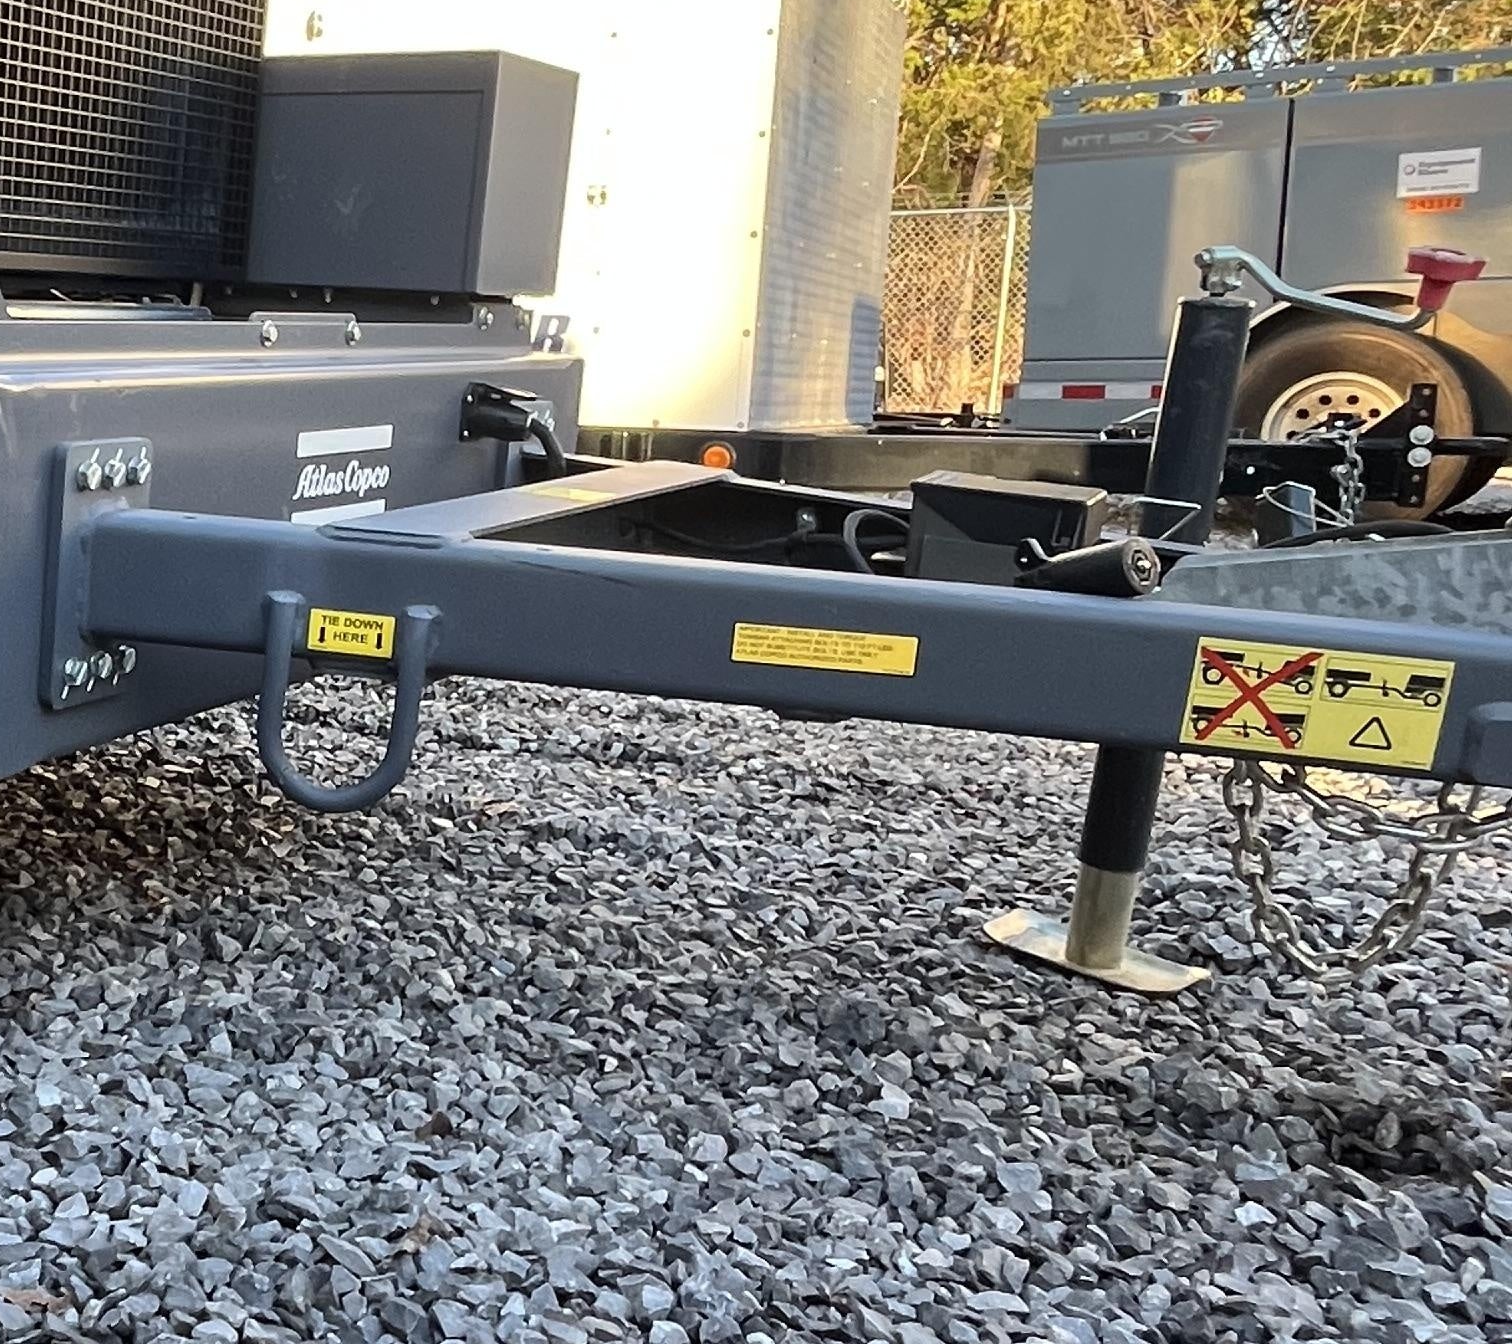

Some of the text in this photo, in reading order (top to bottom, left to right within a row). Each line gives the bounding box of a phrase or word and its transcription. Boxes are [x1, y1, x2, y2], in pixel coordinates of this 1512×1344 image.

[292, 459, 391, 501] Atlas Copco
[321, 614, 384, 632] TIE DOWN
[333, 631, 369, 645] HERE
